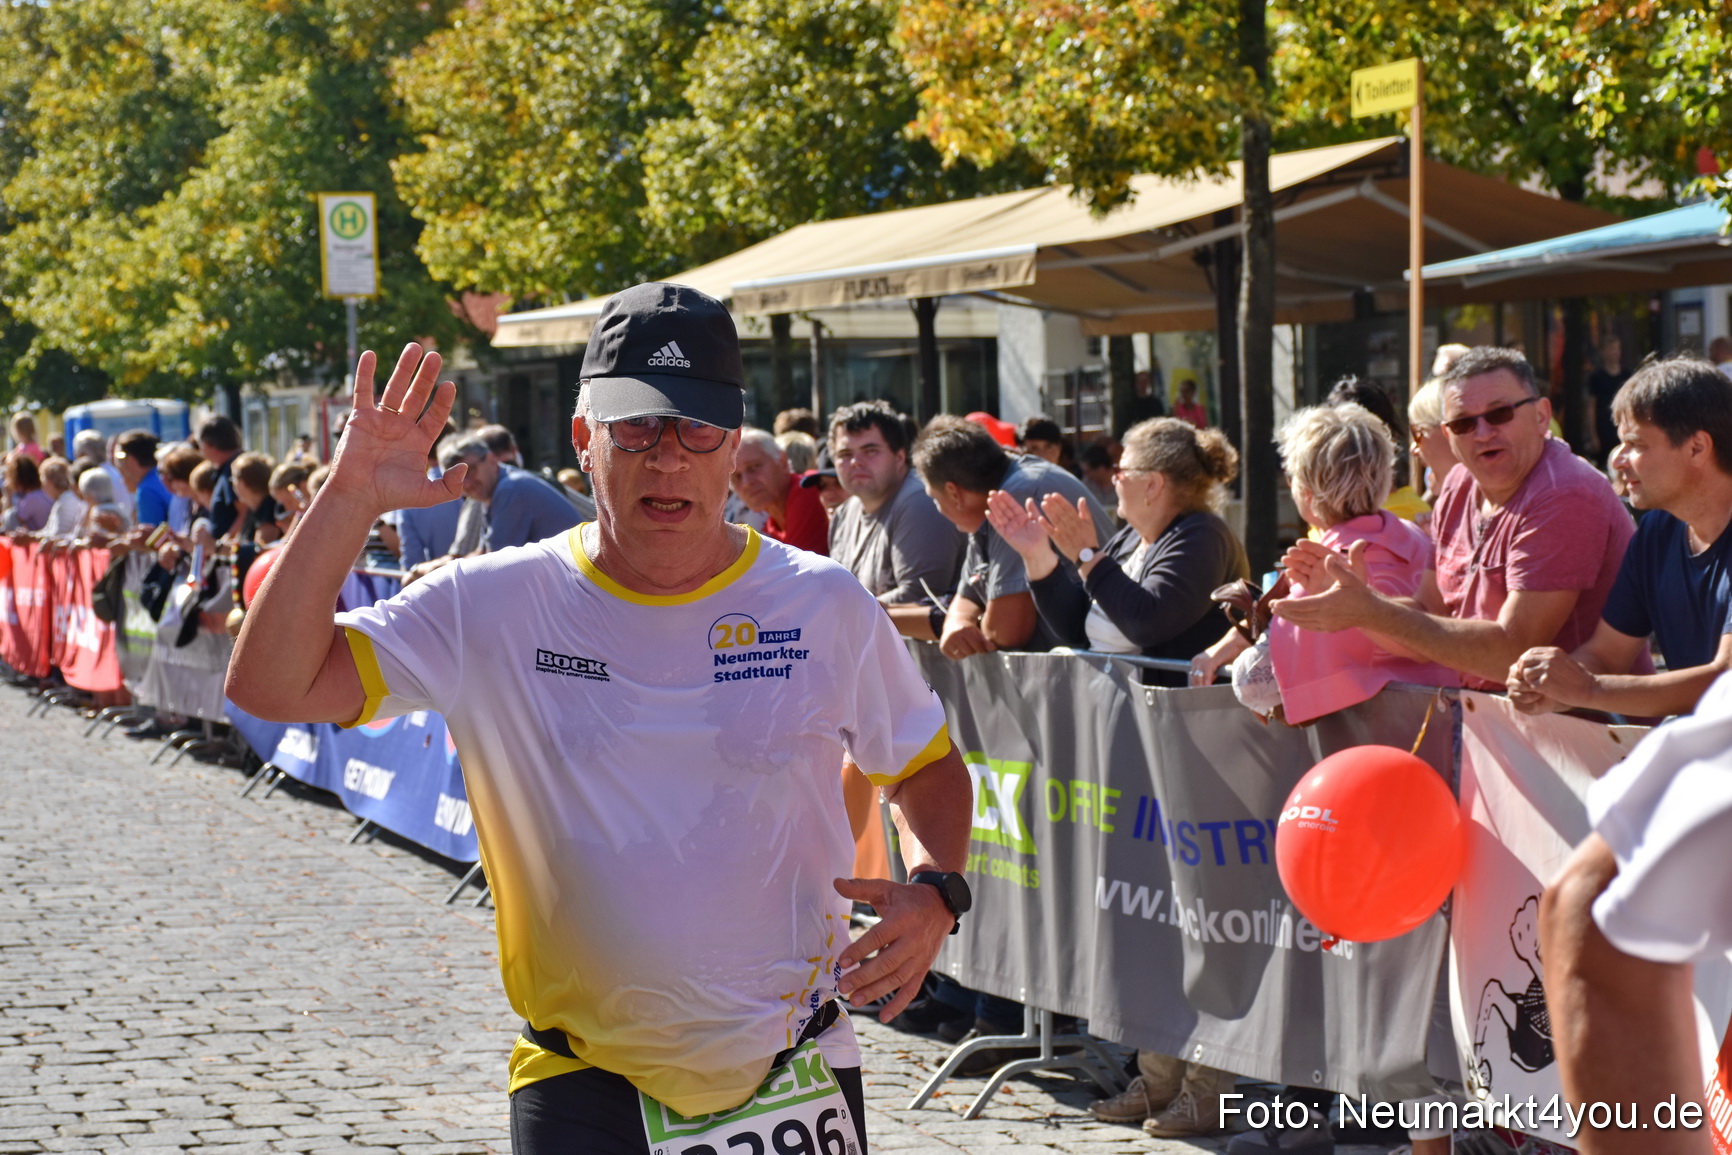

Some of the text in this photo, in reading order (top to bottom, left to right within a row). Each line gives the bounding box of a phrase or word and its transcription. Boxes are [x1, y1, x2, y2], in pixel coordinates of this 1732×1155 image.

[1364, 78, 1413, 100] Toiletten
[647, 355, 691, 369] adidas
[714, 622, 756, 649] 20
[762, 630, 798, 643] JAHRE
[536, 648, 609, 677] BOCK
[714, 646, 810, 667] Neumarkter
[714, 664, 793, 683] Stadtlauf
[1297, 820, 1337, 834] energie
